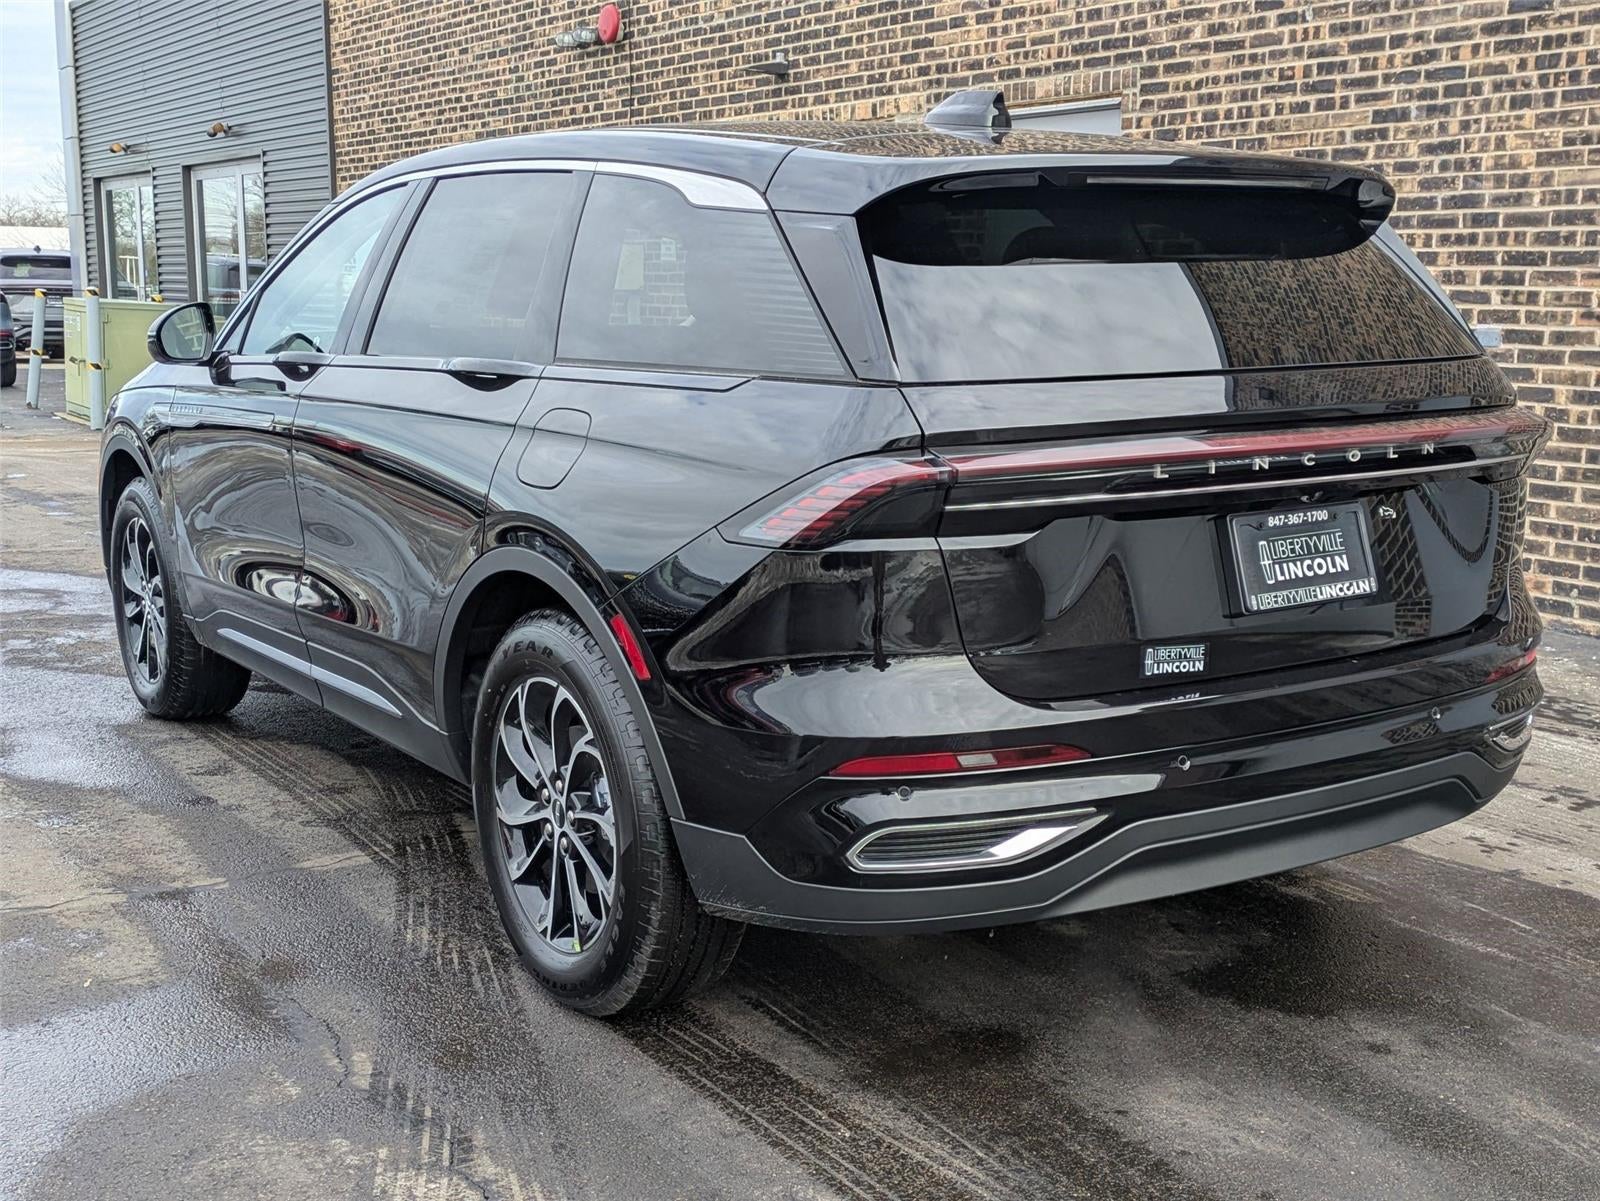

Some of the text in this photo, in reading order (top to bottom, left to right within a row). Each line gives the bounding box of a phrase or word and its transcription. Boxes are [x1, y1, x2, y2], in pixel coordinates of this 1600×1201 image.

[1153, 443, 1435, 478] LINCOLN
[1268, 510, 1328, 527] 847-367-1700
[1269, 532, 1345, 559] LIBERTYVILLE
[1274, 554, 1350, 581] LINCOLN
[1154, 647, 1205, 660] LIBERTYVILLE
[1153, 660, 1204, 674] LINCOLN
